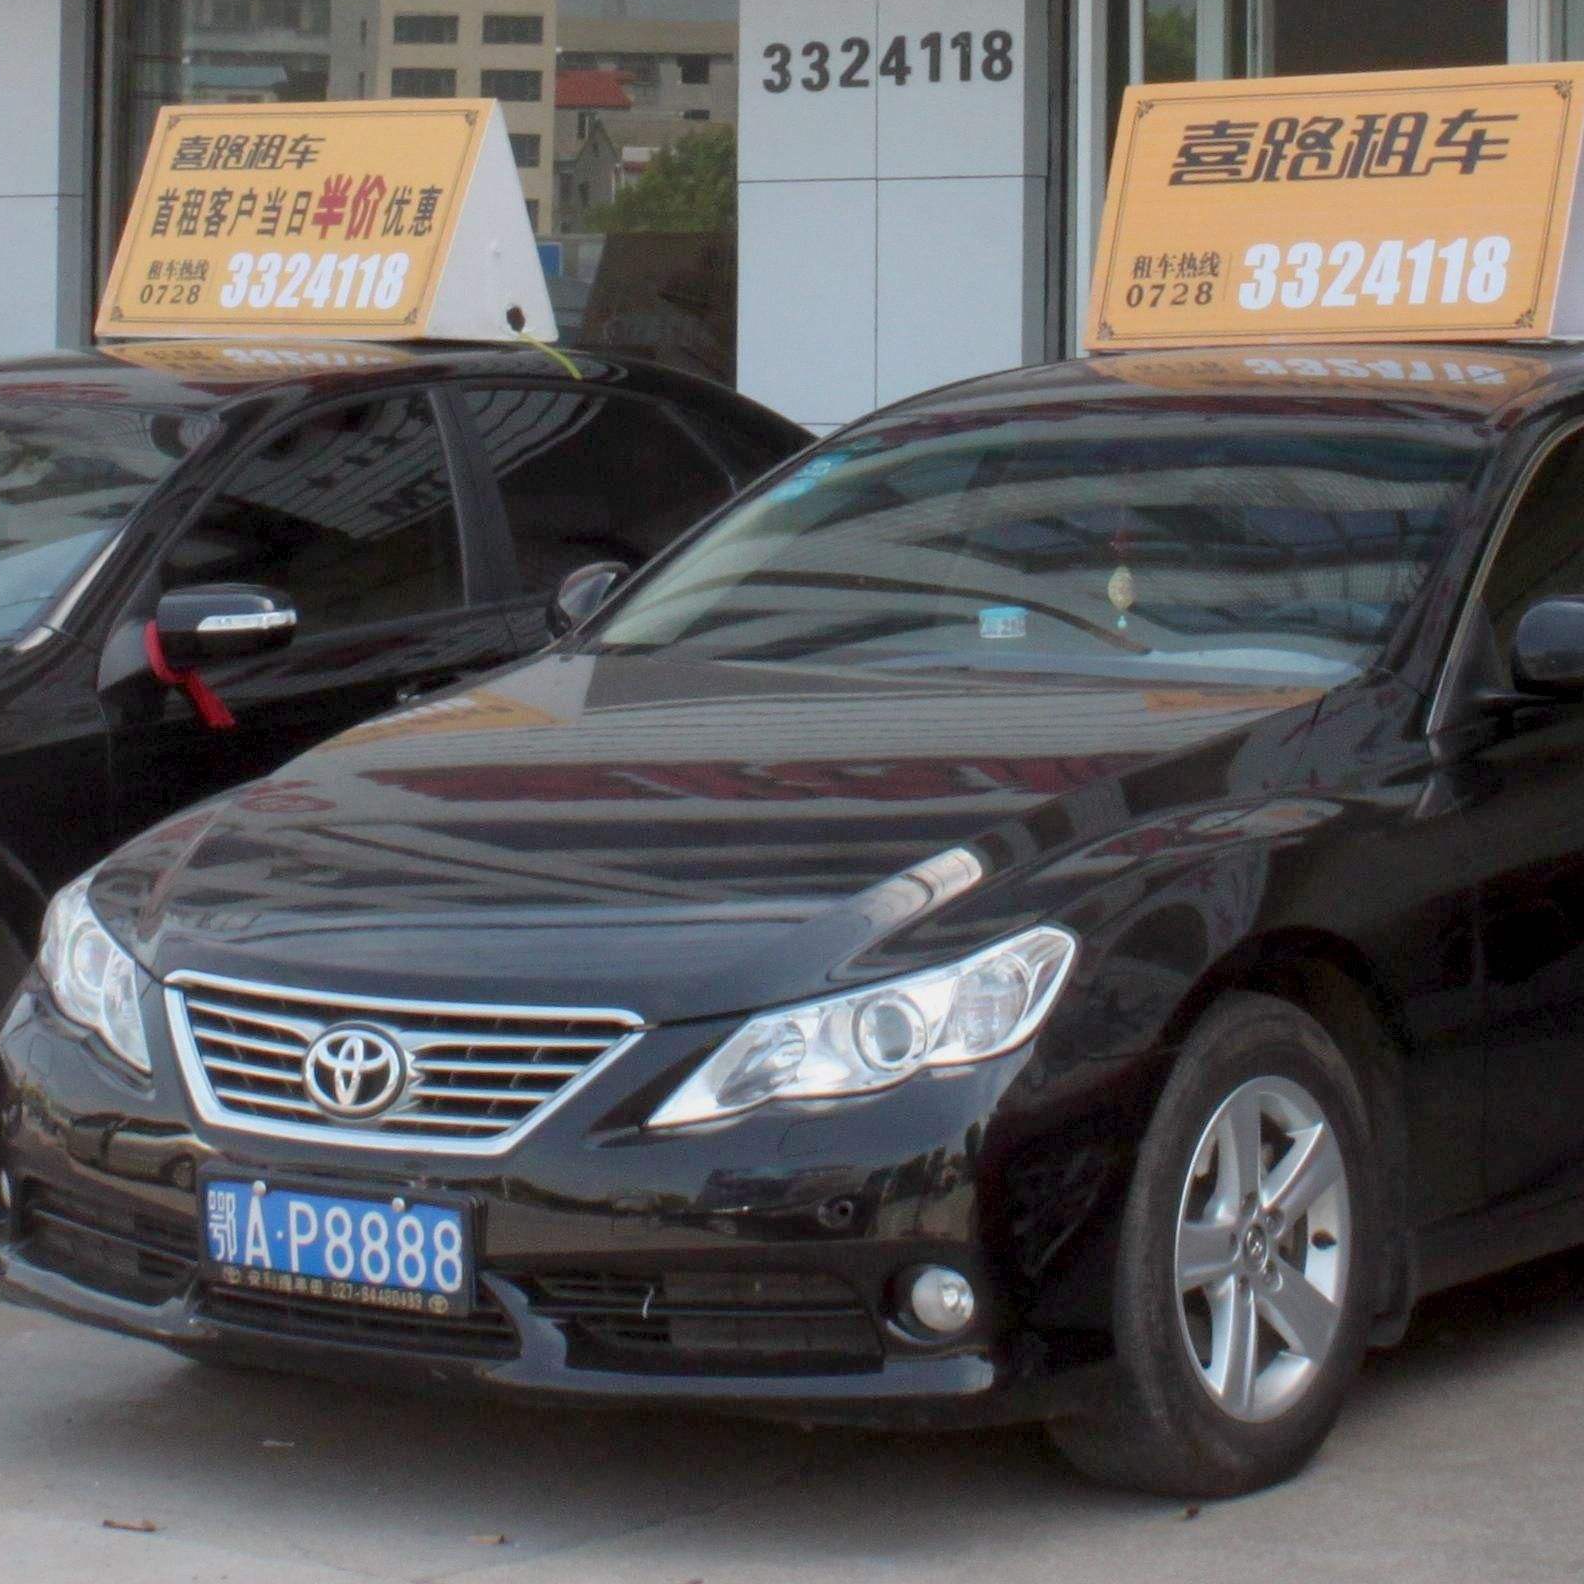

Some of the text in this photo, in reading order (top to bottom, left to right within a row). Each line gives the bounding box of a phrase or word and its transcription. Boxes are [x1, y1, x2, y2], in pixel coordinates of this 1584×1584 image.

[762, 29, 1014, 94] 3324118
[170, 134, 326, 170] 喜路租车
[1169, 108, 1519, 187] 喜路租车
[219, 251, 410, 309] 3324118
[1131, 251, 1222, 280] 租车热线
[1238, 234, 1512, 311] 3324118
[139, 283, 201, 306] 0728
[1125, 282, 1215, 309] 0728
